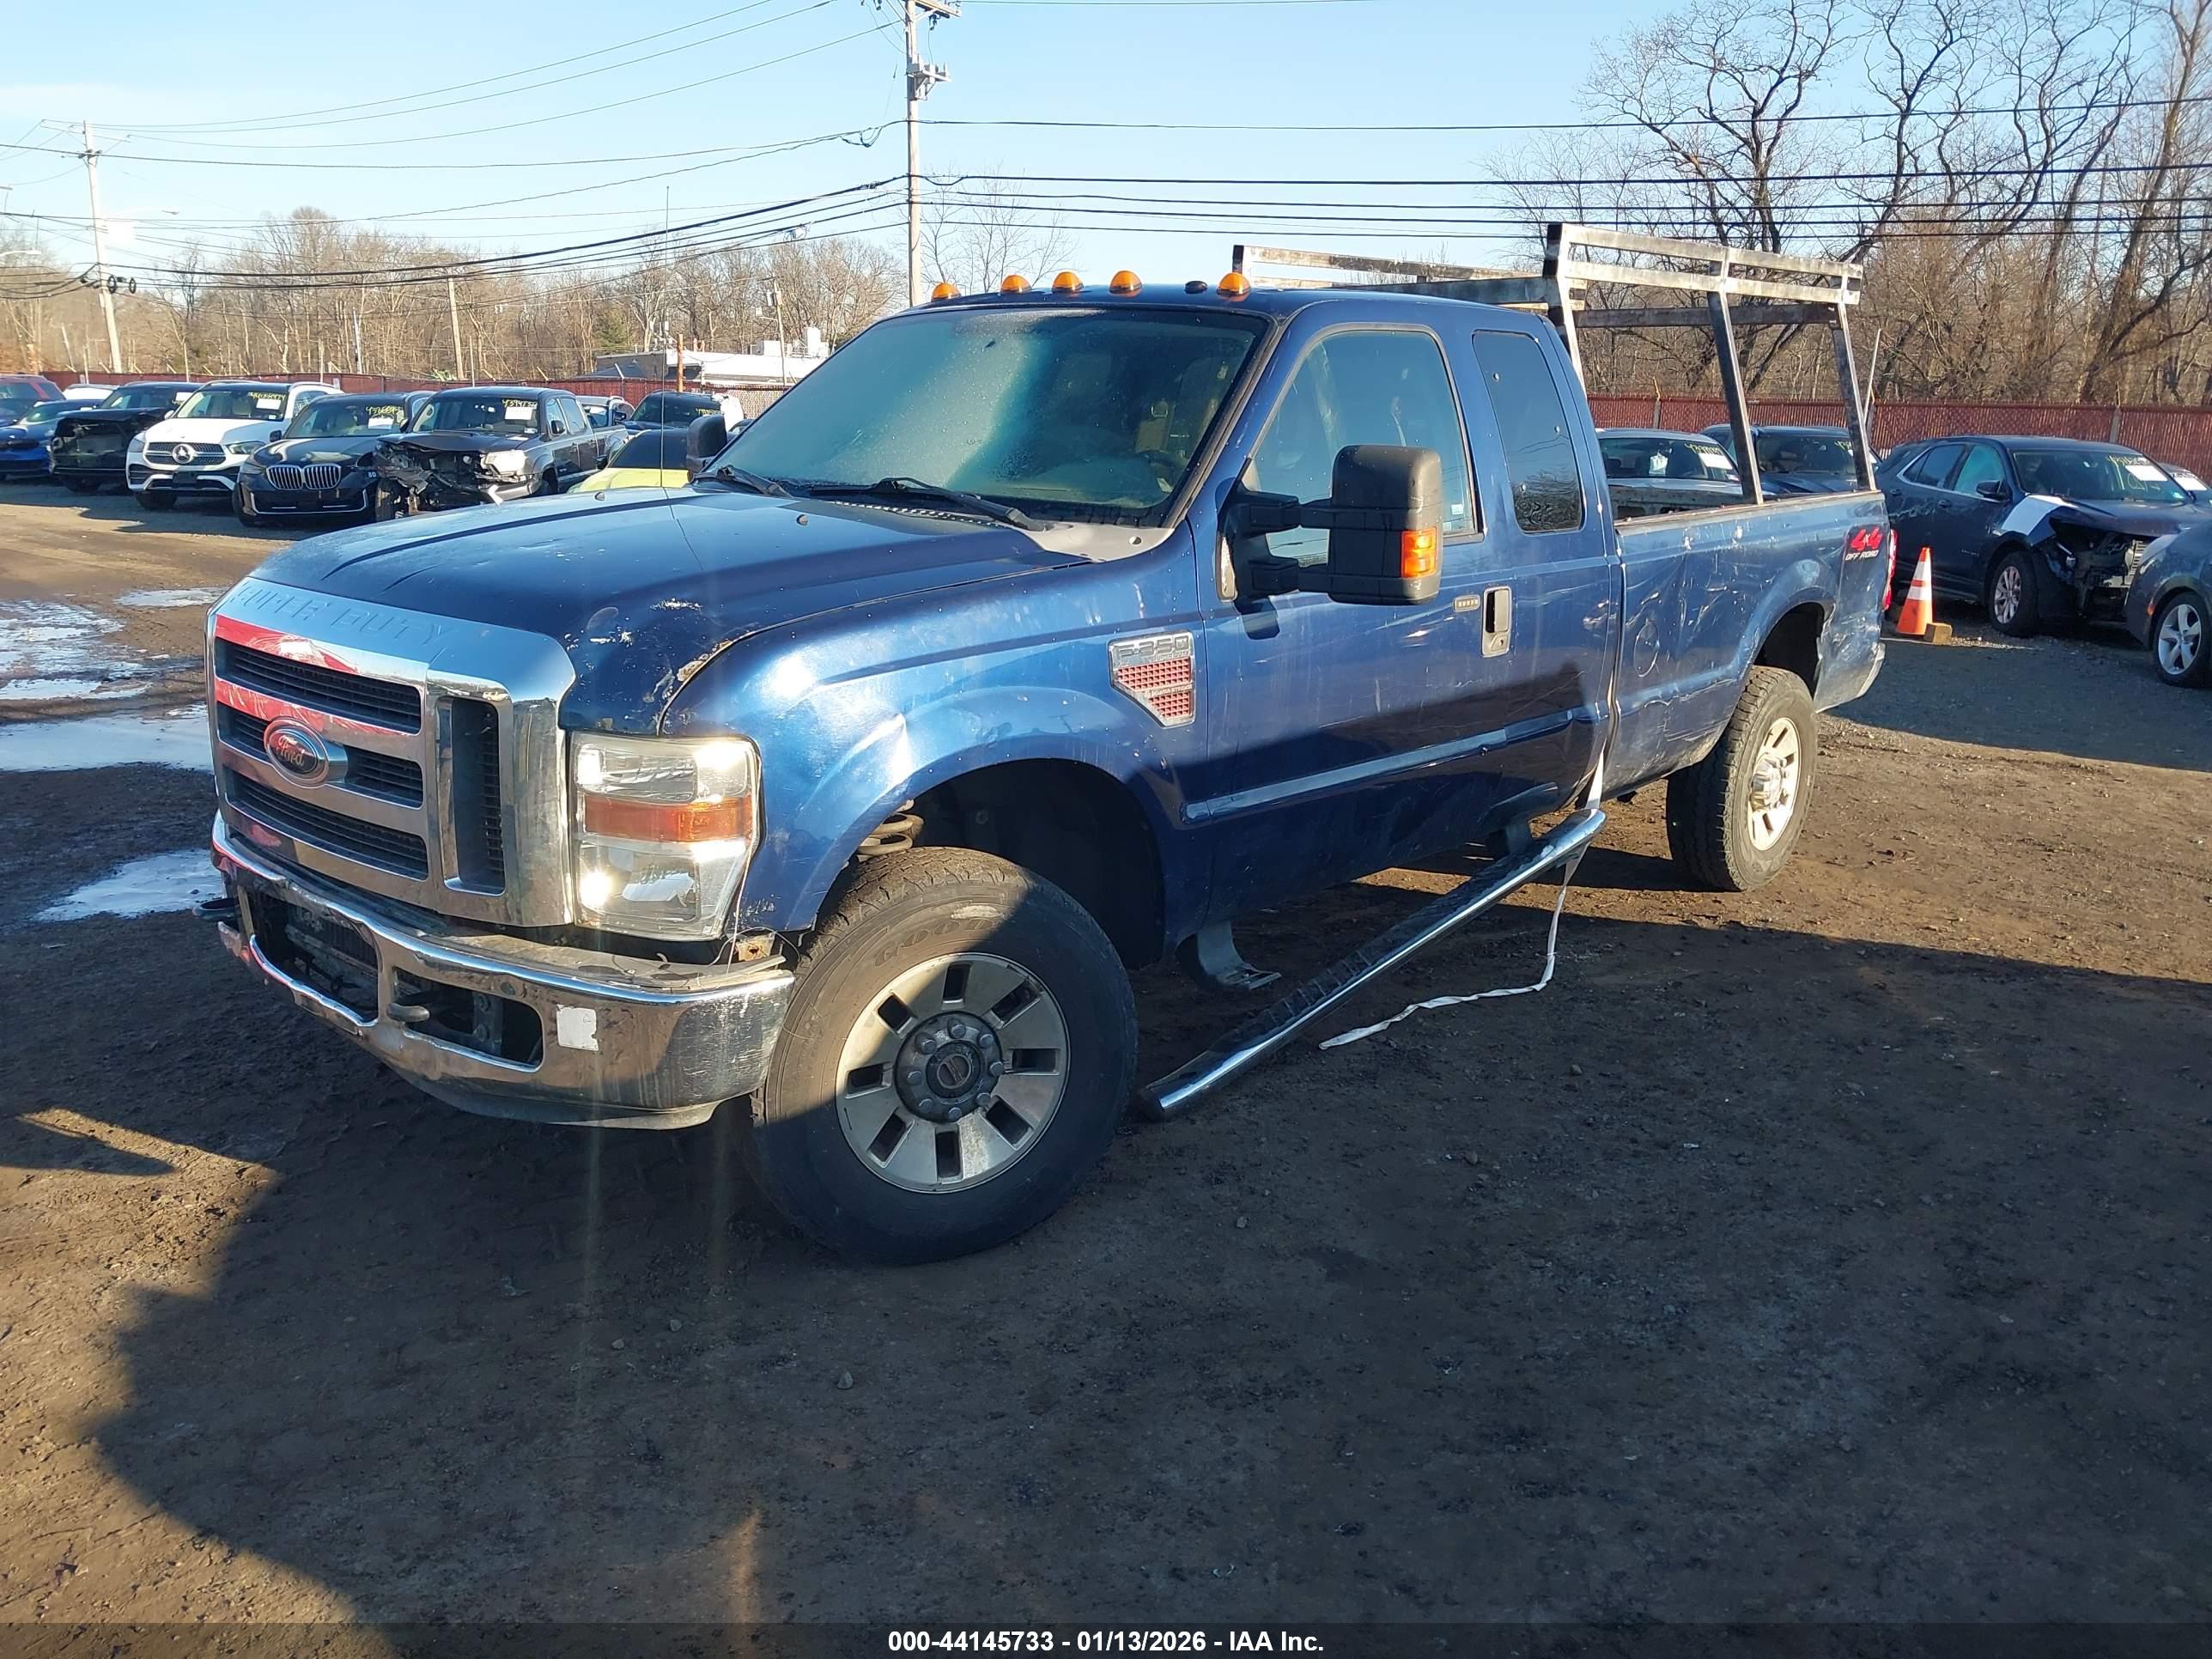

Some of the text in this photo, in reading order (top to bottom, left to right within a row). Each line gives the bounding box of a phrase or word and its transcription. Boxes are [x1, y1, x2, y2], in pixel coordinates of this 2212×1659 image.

[1845, 550, 1880, 562] OFF ROAD
[229, 584, 455, 647] SUPER DUTY
[276, 735, 306, 767] Ford
